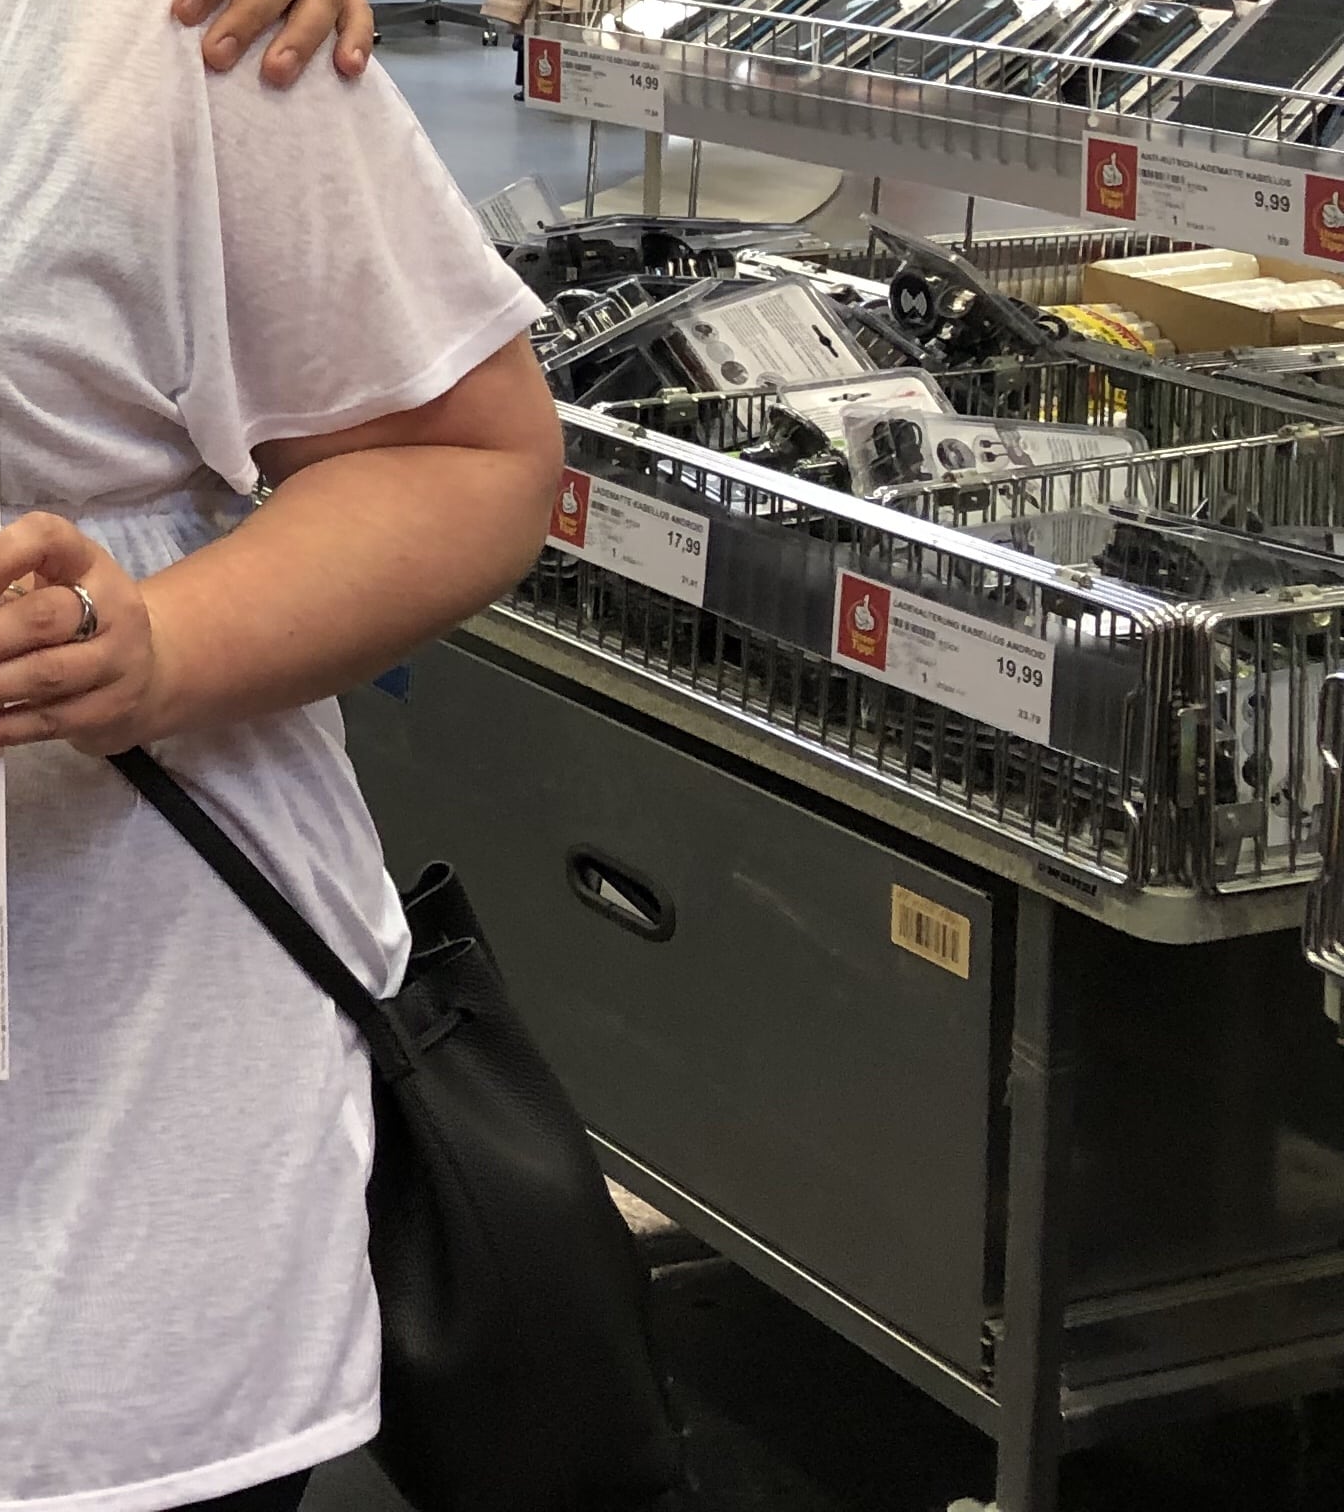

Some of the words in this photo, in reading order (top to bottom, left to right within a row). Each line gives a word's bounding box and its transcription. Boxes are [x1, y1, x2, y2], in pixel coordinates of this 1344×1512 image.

[629, 73, 660, 91] 14,99
[1245, 170, 1293, 188] KABELLOS
[1254, 190, 1291, 214] 9,99
[633, 500, 671, 522] KABELLOS
[671, 515, 705, 534] ANDROID
[666, 530, 702, 557] 17,99
[961, 622, 1006, 648] KABELLOS
[1006, 640, 1047, 662] ANDROID
[996, 655, 1044, 688] 19,99
